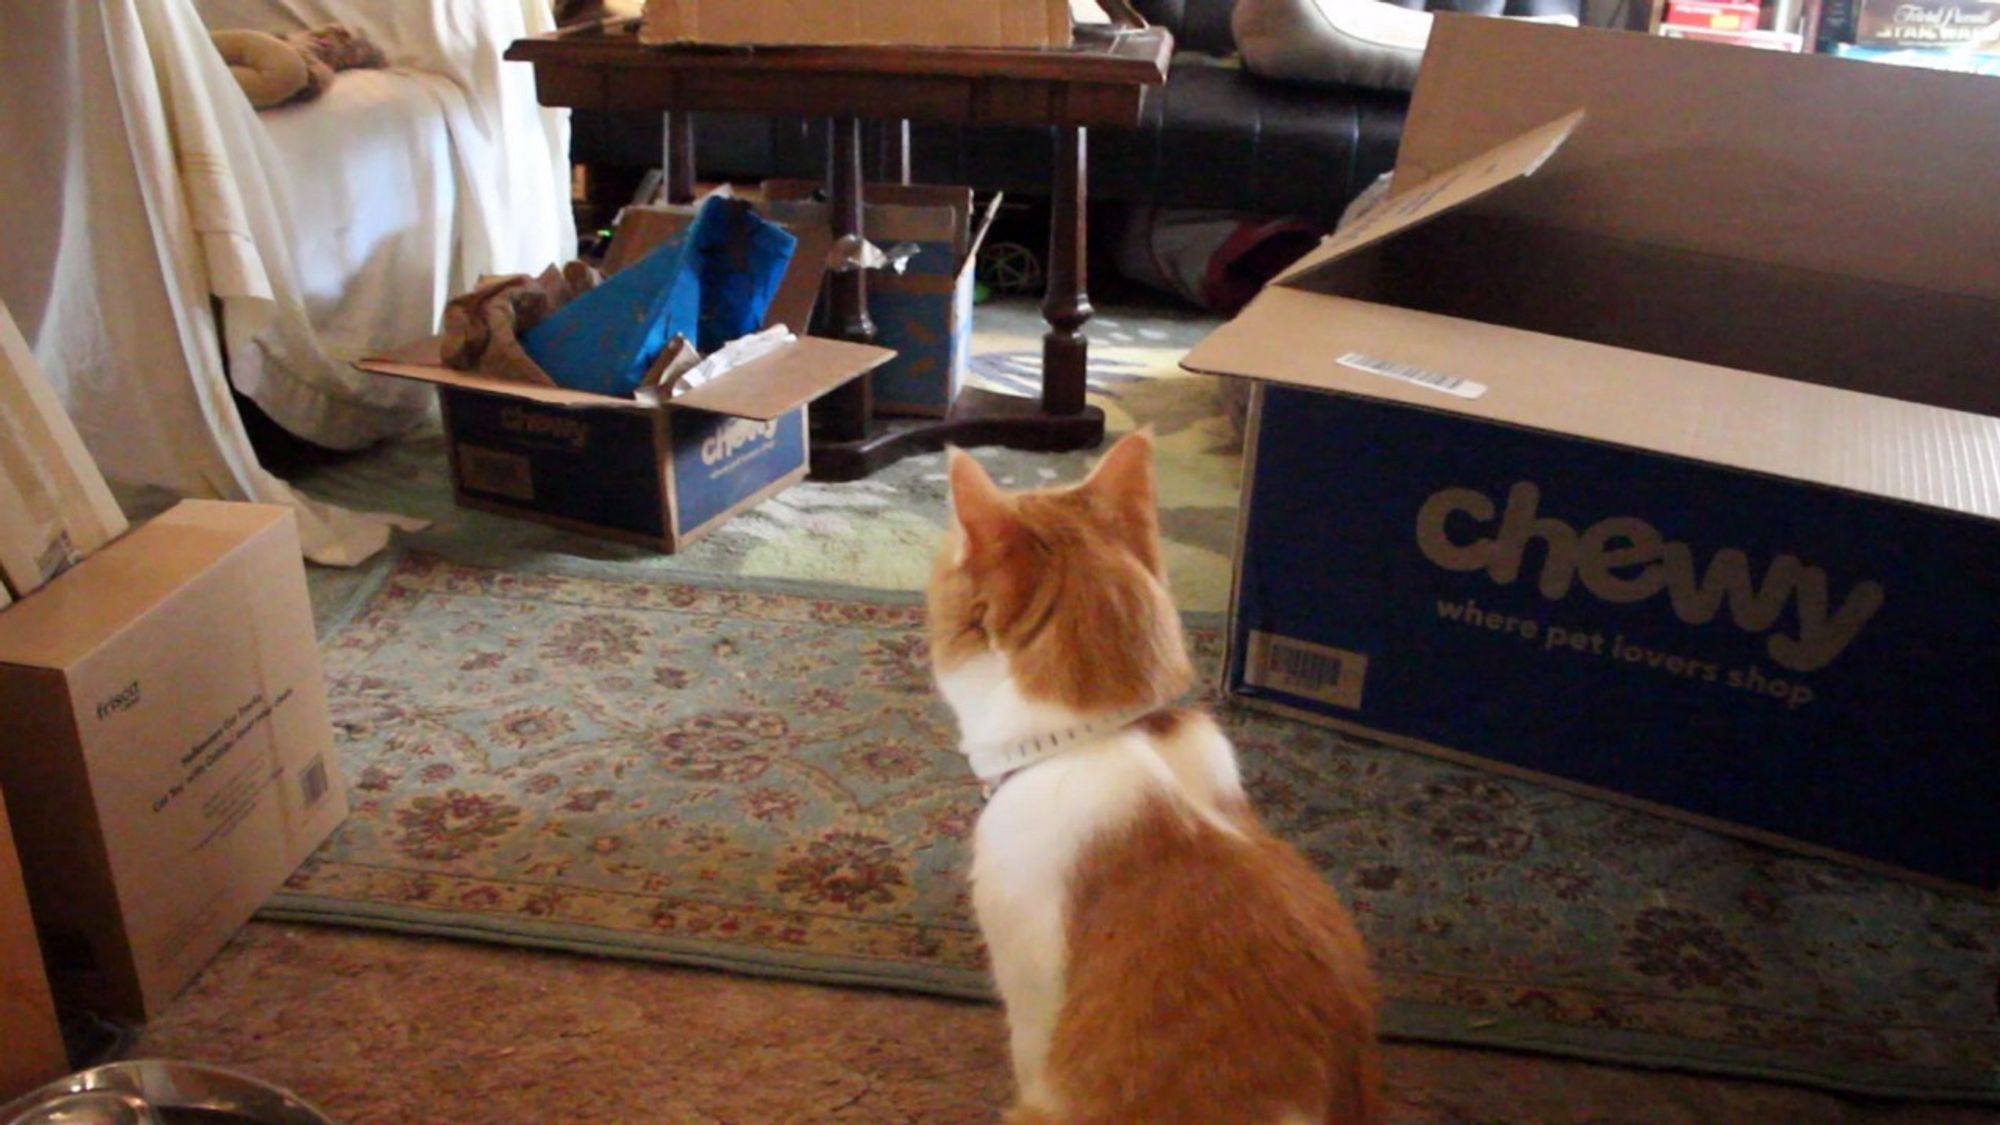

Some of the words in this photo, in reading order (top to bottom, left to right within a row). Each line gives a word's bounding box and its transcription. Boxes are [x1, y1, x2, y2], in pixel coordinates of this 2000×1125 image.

[1416, 481, 1885, 672] chewy
[1436, 599, 1537, 640] where
[1545, 624, 1603, 656] pet
[1611, 634, 1718, 682] lovers
[1726, 662, 1814, 707] shop
